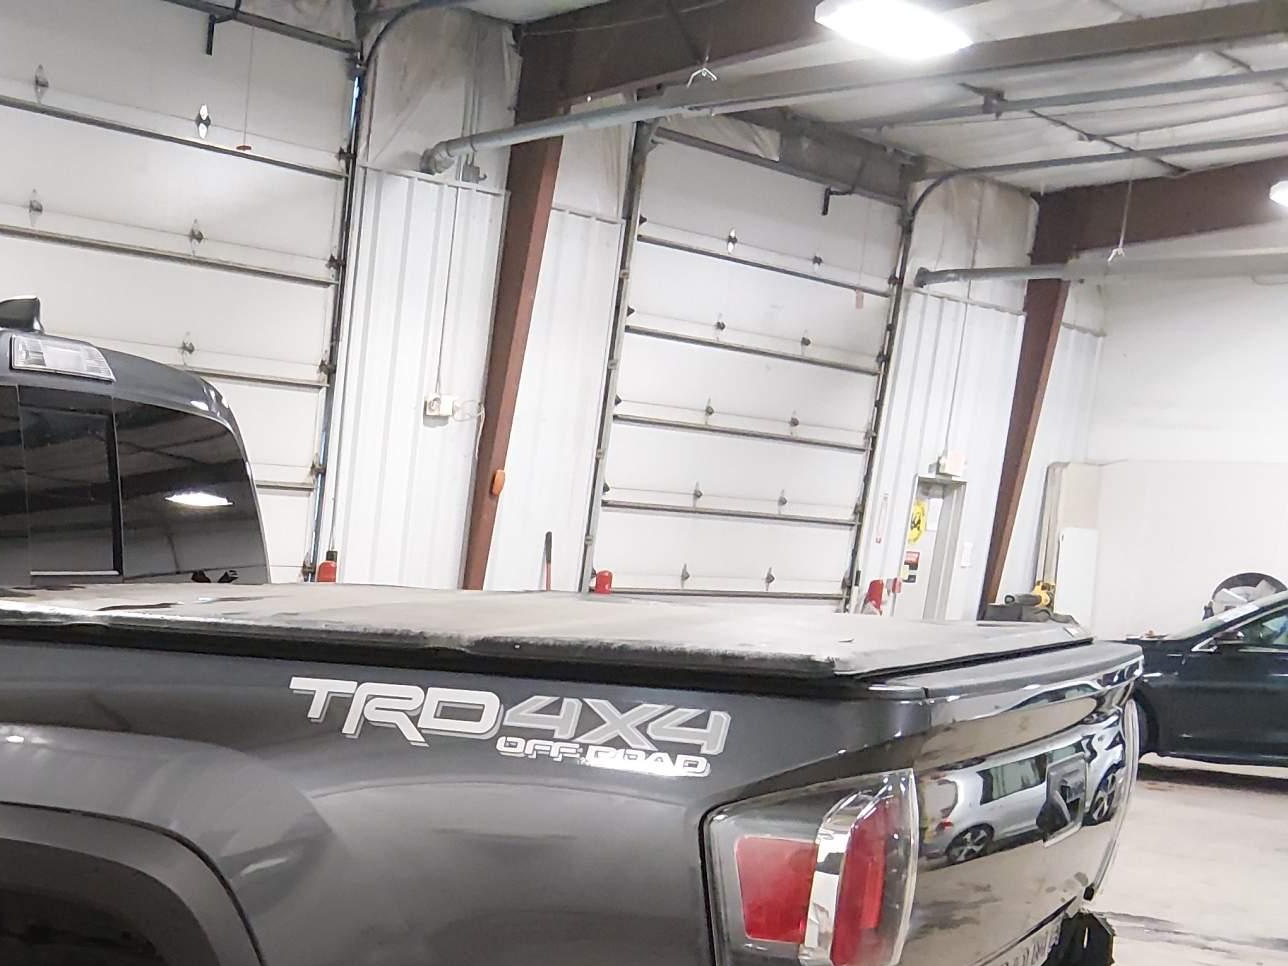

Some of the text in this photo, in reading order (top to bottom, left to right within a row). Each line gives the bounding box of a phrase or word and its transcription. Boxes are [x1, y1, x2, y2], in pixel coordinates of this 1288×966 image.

[289, 676, 731, 755] TRD 4X4
[495, 736, 711, 777] OFF ROAD
